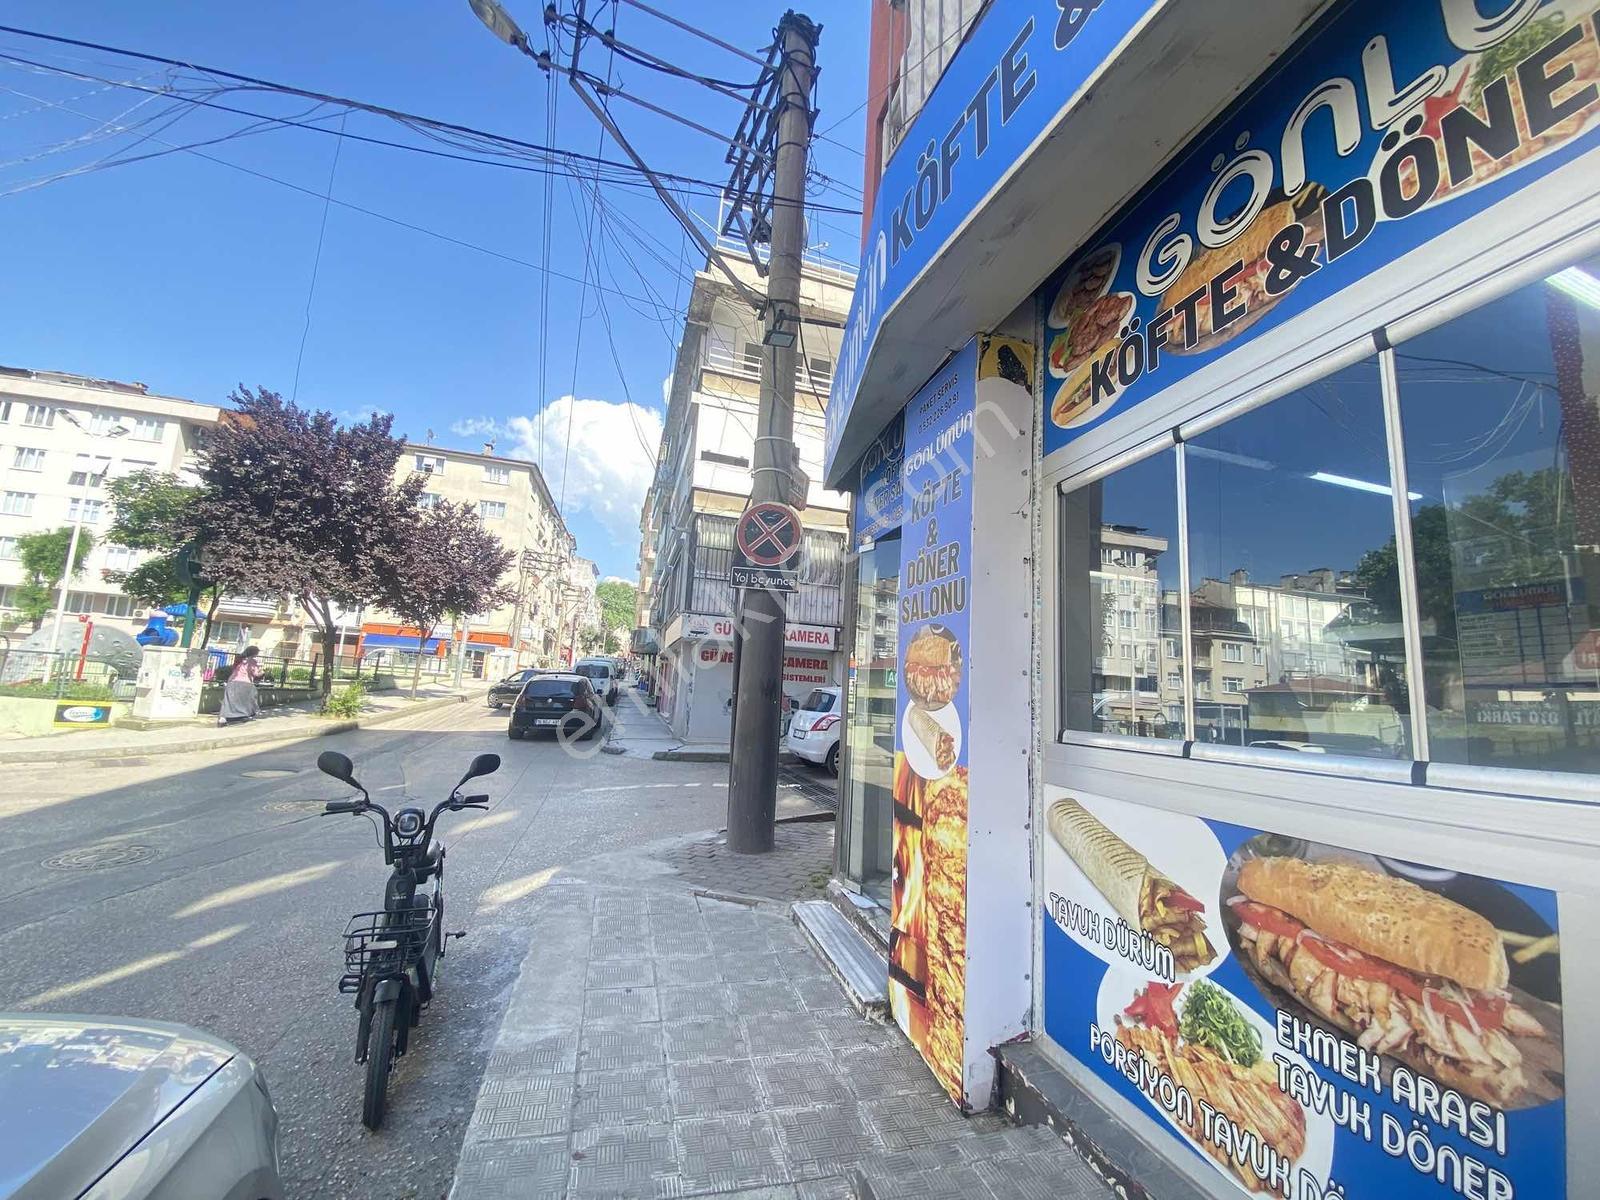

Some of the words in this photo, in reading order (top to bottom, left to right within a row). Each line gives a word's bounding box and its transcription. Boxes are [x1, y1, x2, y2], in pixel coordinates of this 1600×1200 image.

[891, 16, 1037, 269] KÖFTE
[1091, 259, 1248, 407] KÖFTE
[1264, 222, 1323, 297] &
[1321, 9, 1600, 264] DÖNE
[906, 410, 973, 476] GÖNLÜMÜN
[911, 467, 962, 525] KÖFTE
[926, 518, 937, 548] &
[734, 572, 749, 583] Yol
[901, 577, 967, 624] SALONU
[907, 541, 960, 590] DÖNER
[1049, 892, 1100, 943] TAVUK
[1103, 917, 1176, 983] DÜRÜM
[1090, 1023, 1195, 1127] PORSİYON
[1199, 1099, 1292, 1200] TAVUK
[1272, 1053, 1373, 1142] TAVUK
[1276, 1009, 1382, 1095] EKMEK
[1391, 1064, 1507, 1156] ARASI
